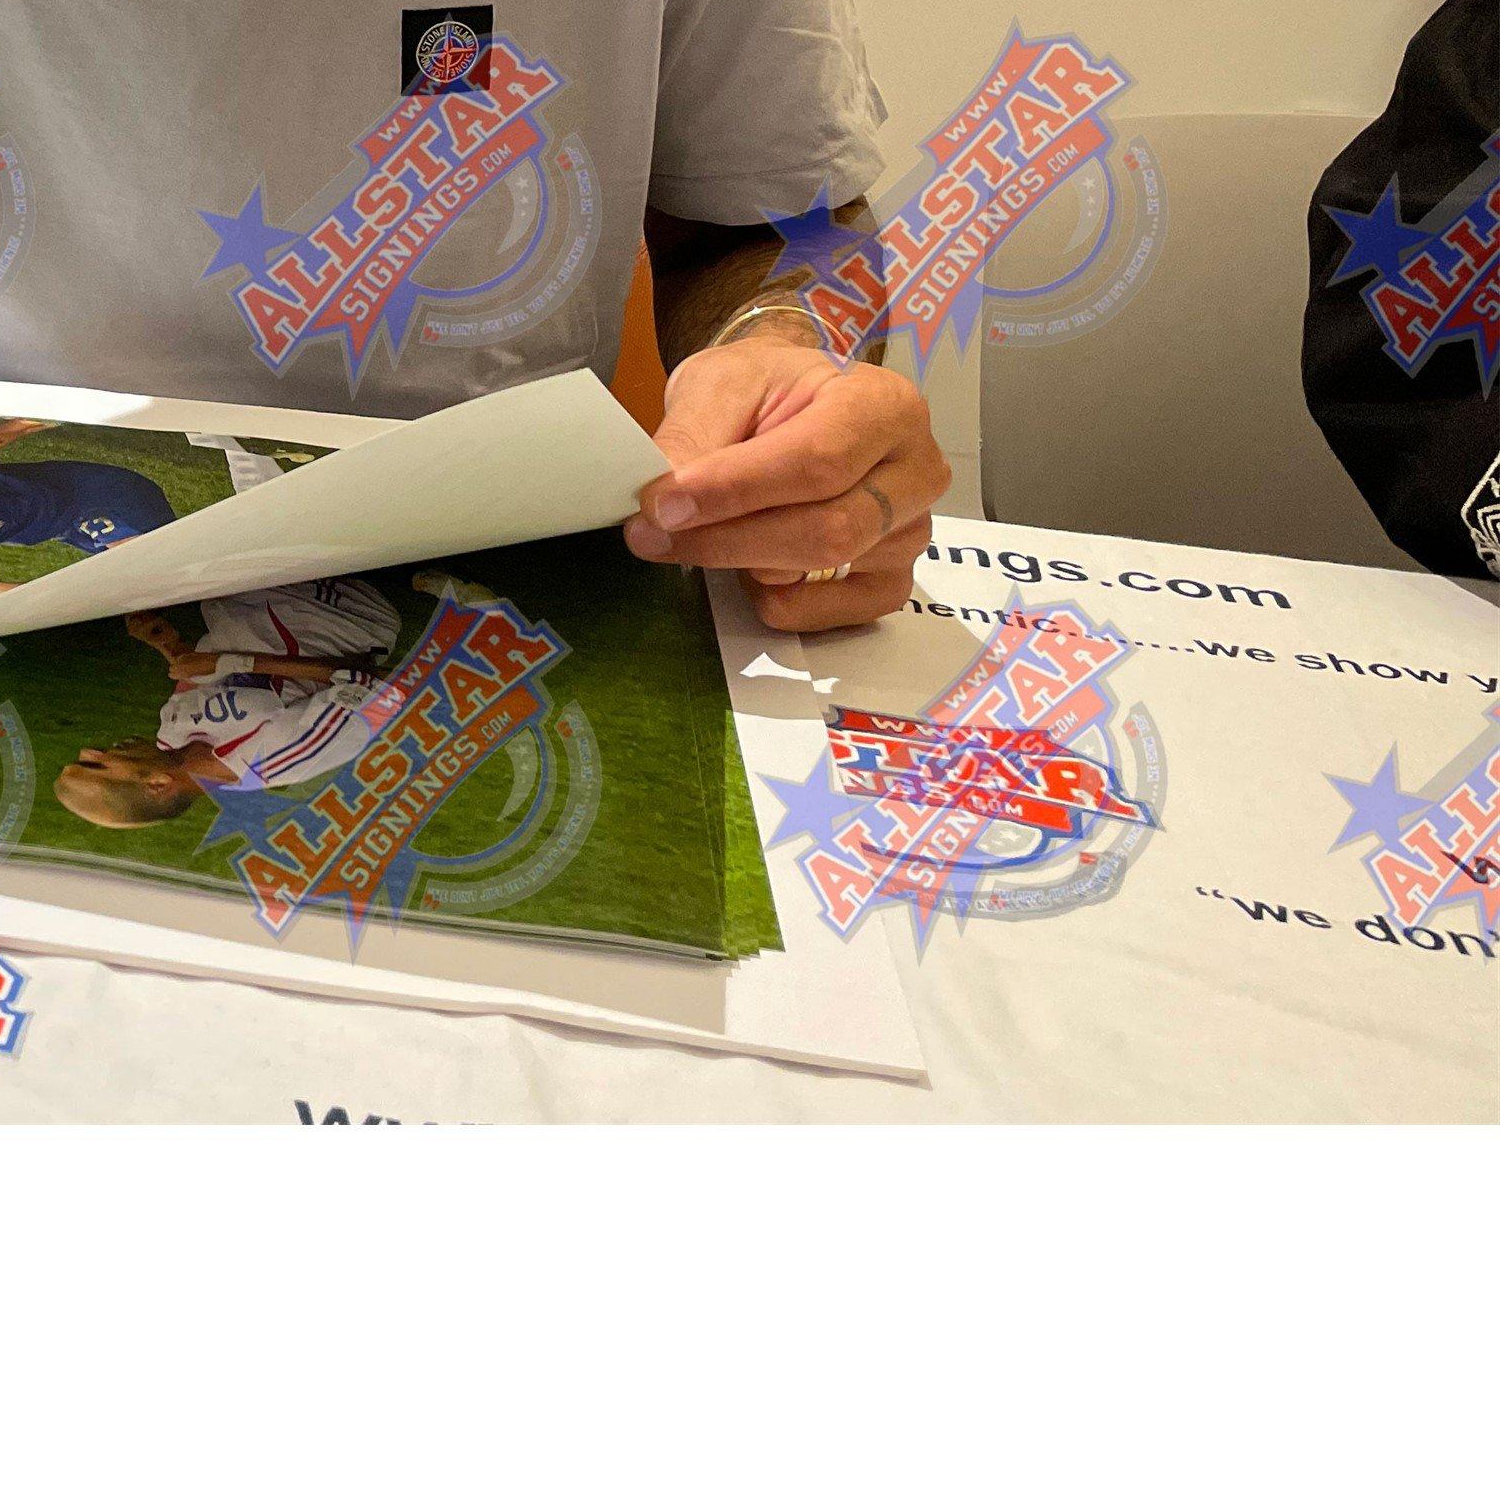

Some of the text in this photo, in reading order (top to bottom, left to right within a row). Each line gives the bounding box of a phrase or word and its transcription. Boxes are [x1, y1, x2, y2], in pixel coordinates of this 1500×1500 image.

[421, 24, 476, 52] STONE ISLAND
[1294, 652, 1449, 684] show
